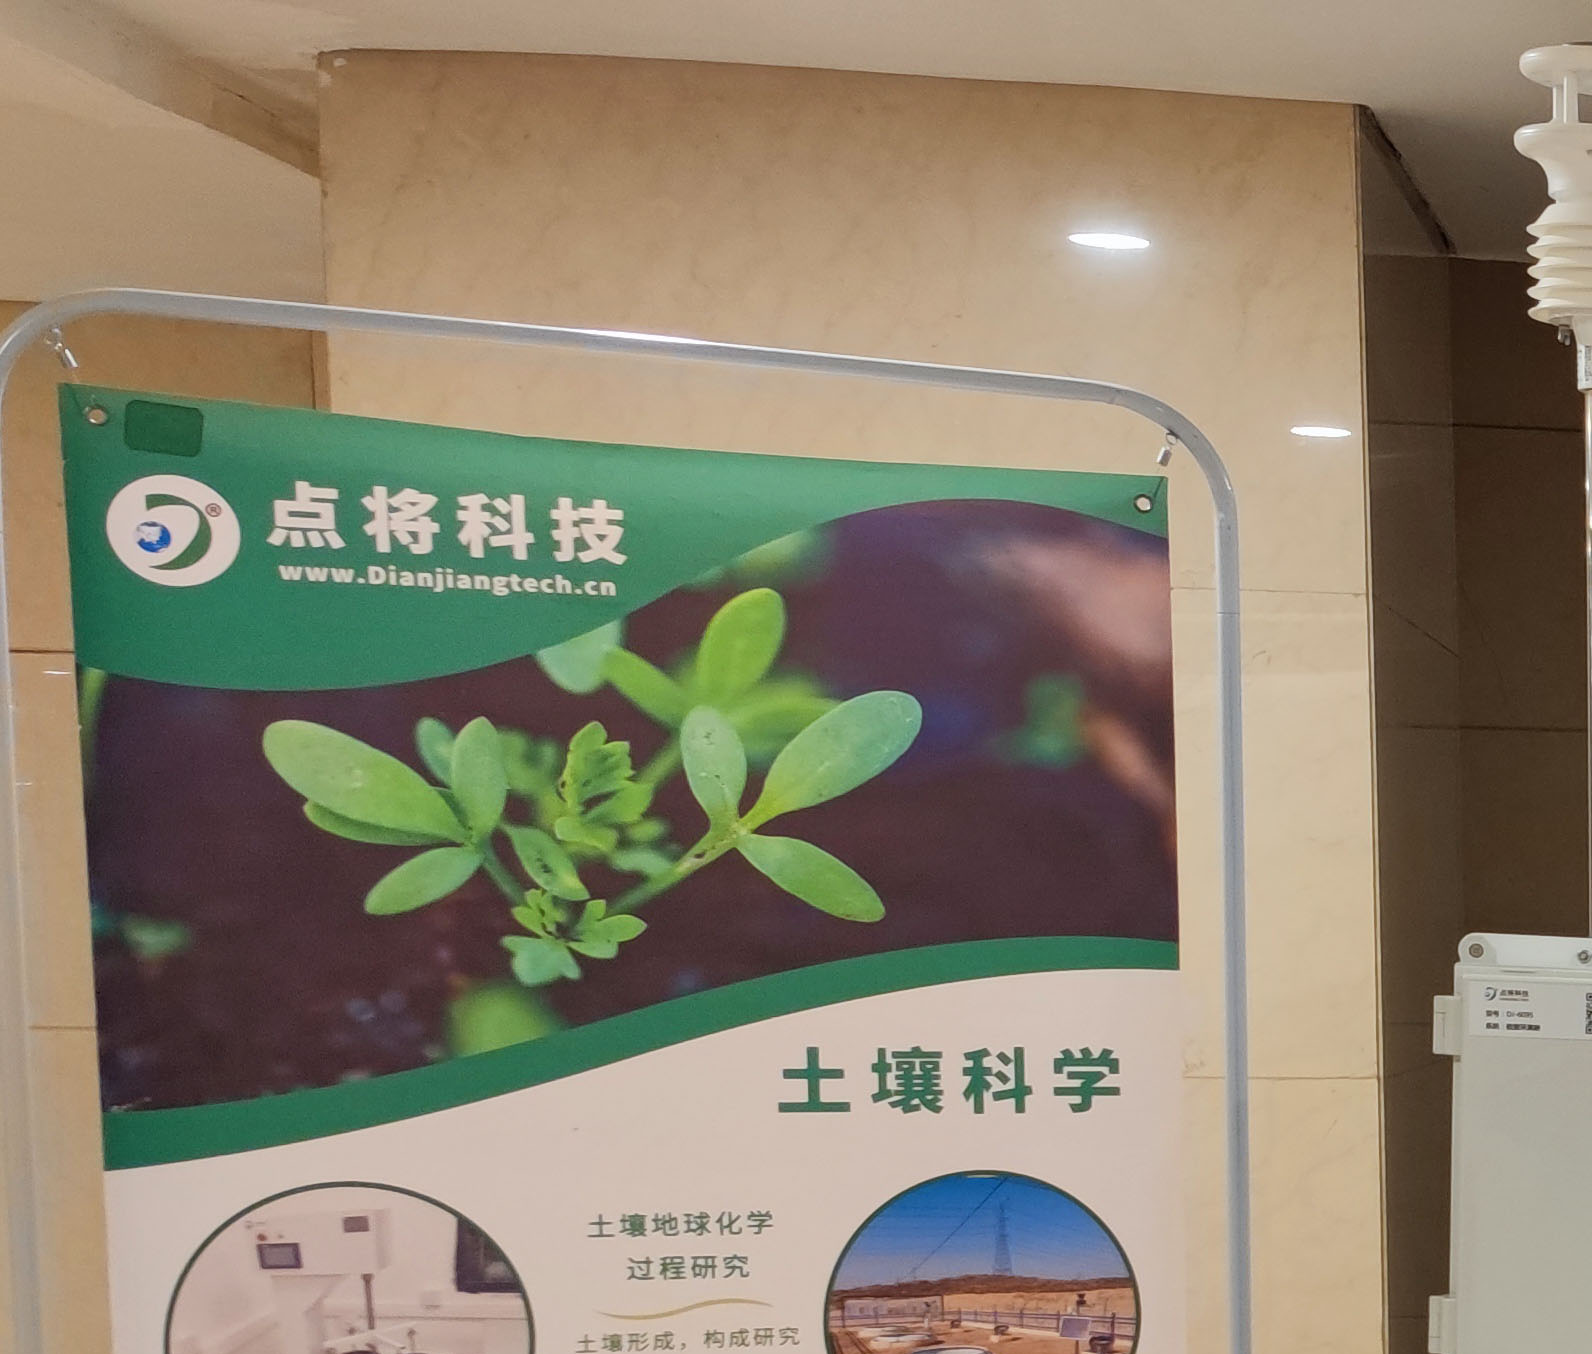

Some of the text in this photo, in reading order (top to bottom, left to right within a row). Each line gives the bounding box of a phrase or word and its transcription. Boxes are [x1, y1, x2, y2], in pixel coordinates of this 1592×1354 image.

[267, 480, 628, 566] 点将科技
[278, 563, 617, 597] www.Dianjiangtech.cn
[778, 1046, 1121, 1114] 土壤科学
[587, 1210, 774, 1238] 土壤地球化学
[626, 1254, 750, 1281] 过程研究
[575, 1327, 801, 1354] 土壤形成，构成研究
